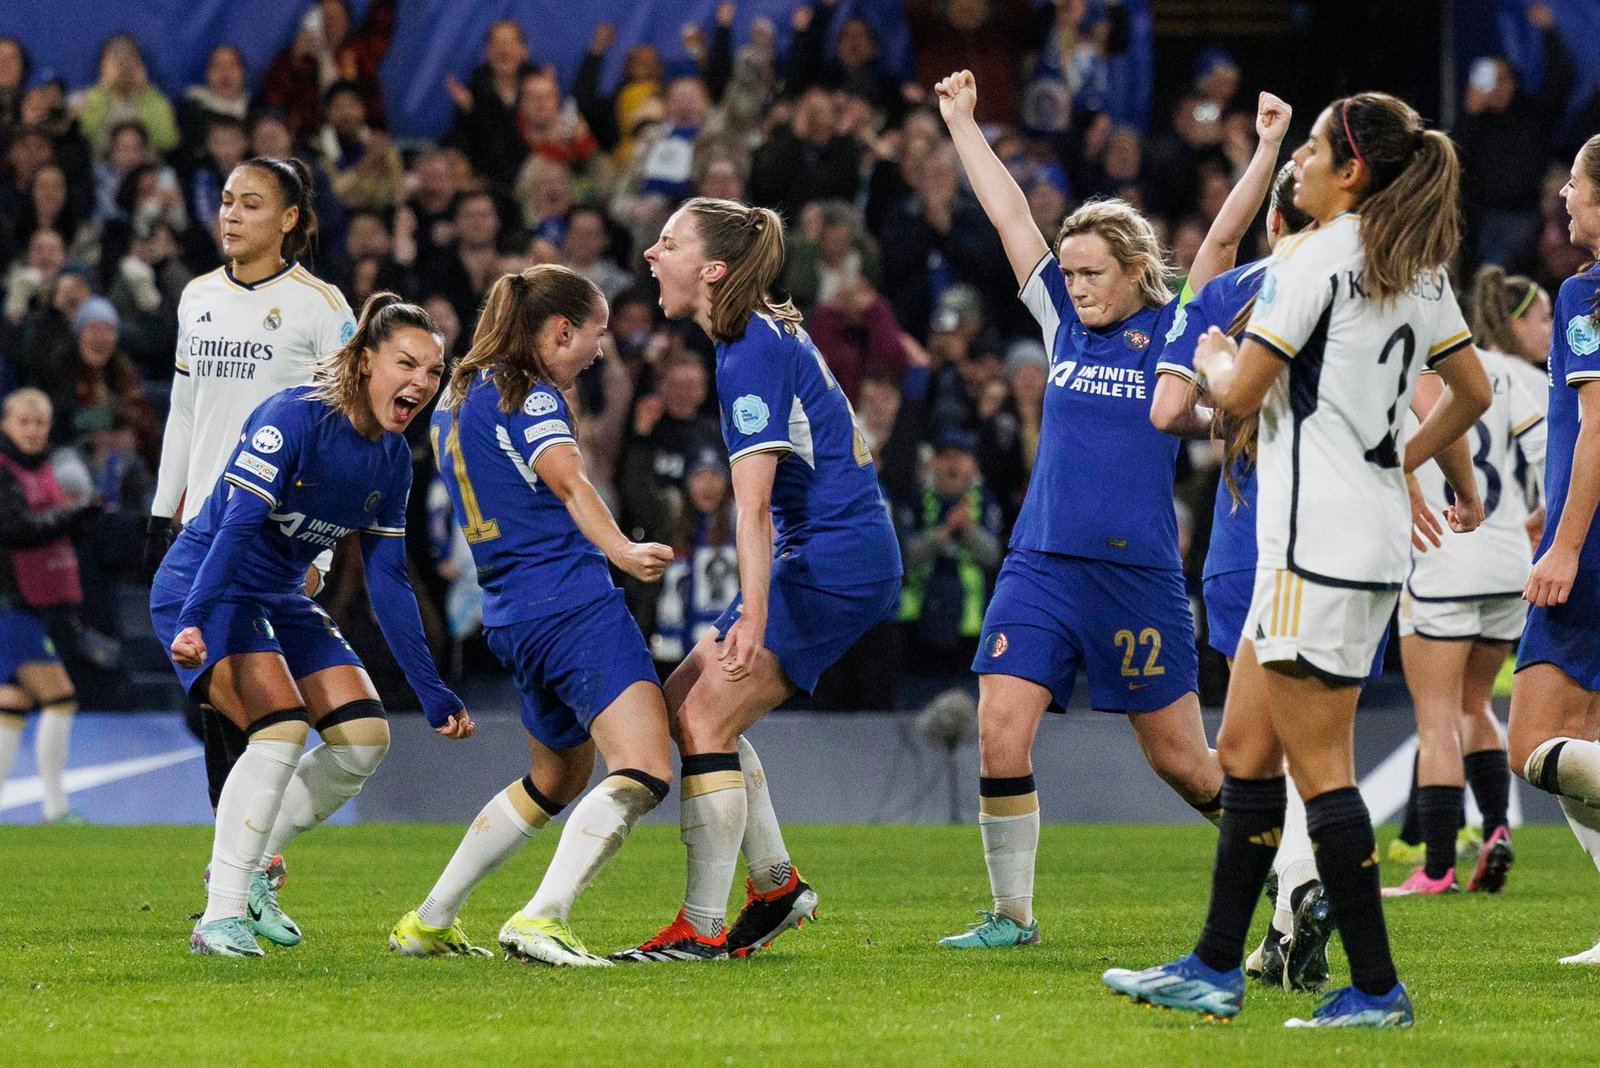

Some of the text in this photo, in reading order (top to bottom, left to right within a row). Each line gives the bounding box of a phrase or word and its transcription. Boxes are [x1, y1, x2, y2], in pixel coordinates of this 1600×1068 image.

[190, 336, 274, 361] Emirates
[196, 360, 256, 380] FLY BETTER
[1077, 365, 1145, 384] INFINITE
[1069, 378, 1147, 399] ATHLETE
[1113, 626, 1166, 677] 22
